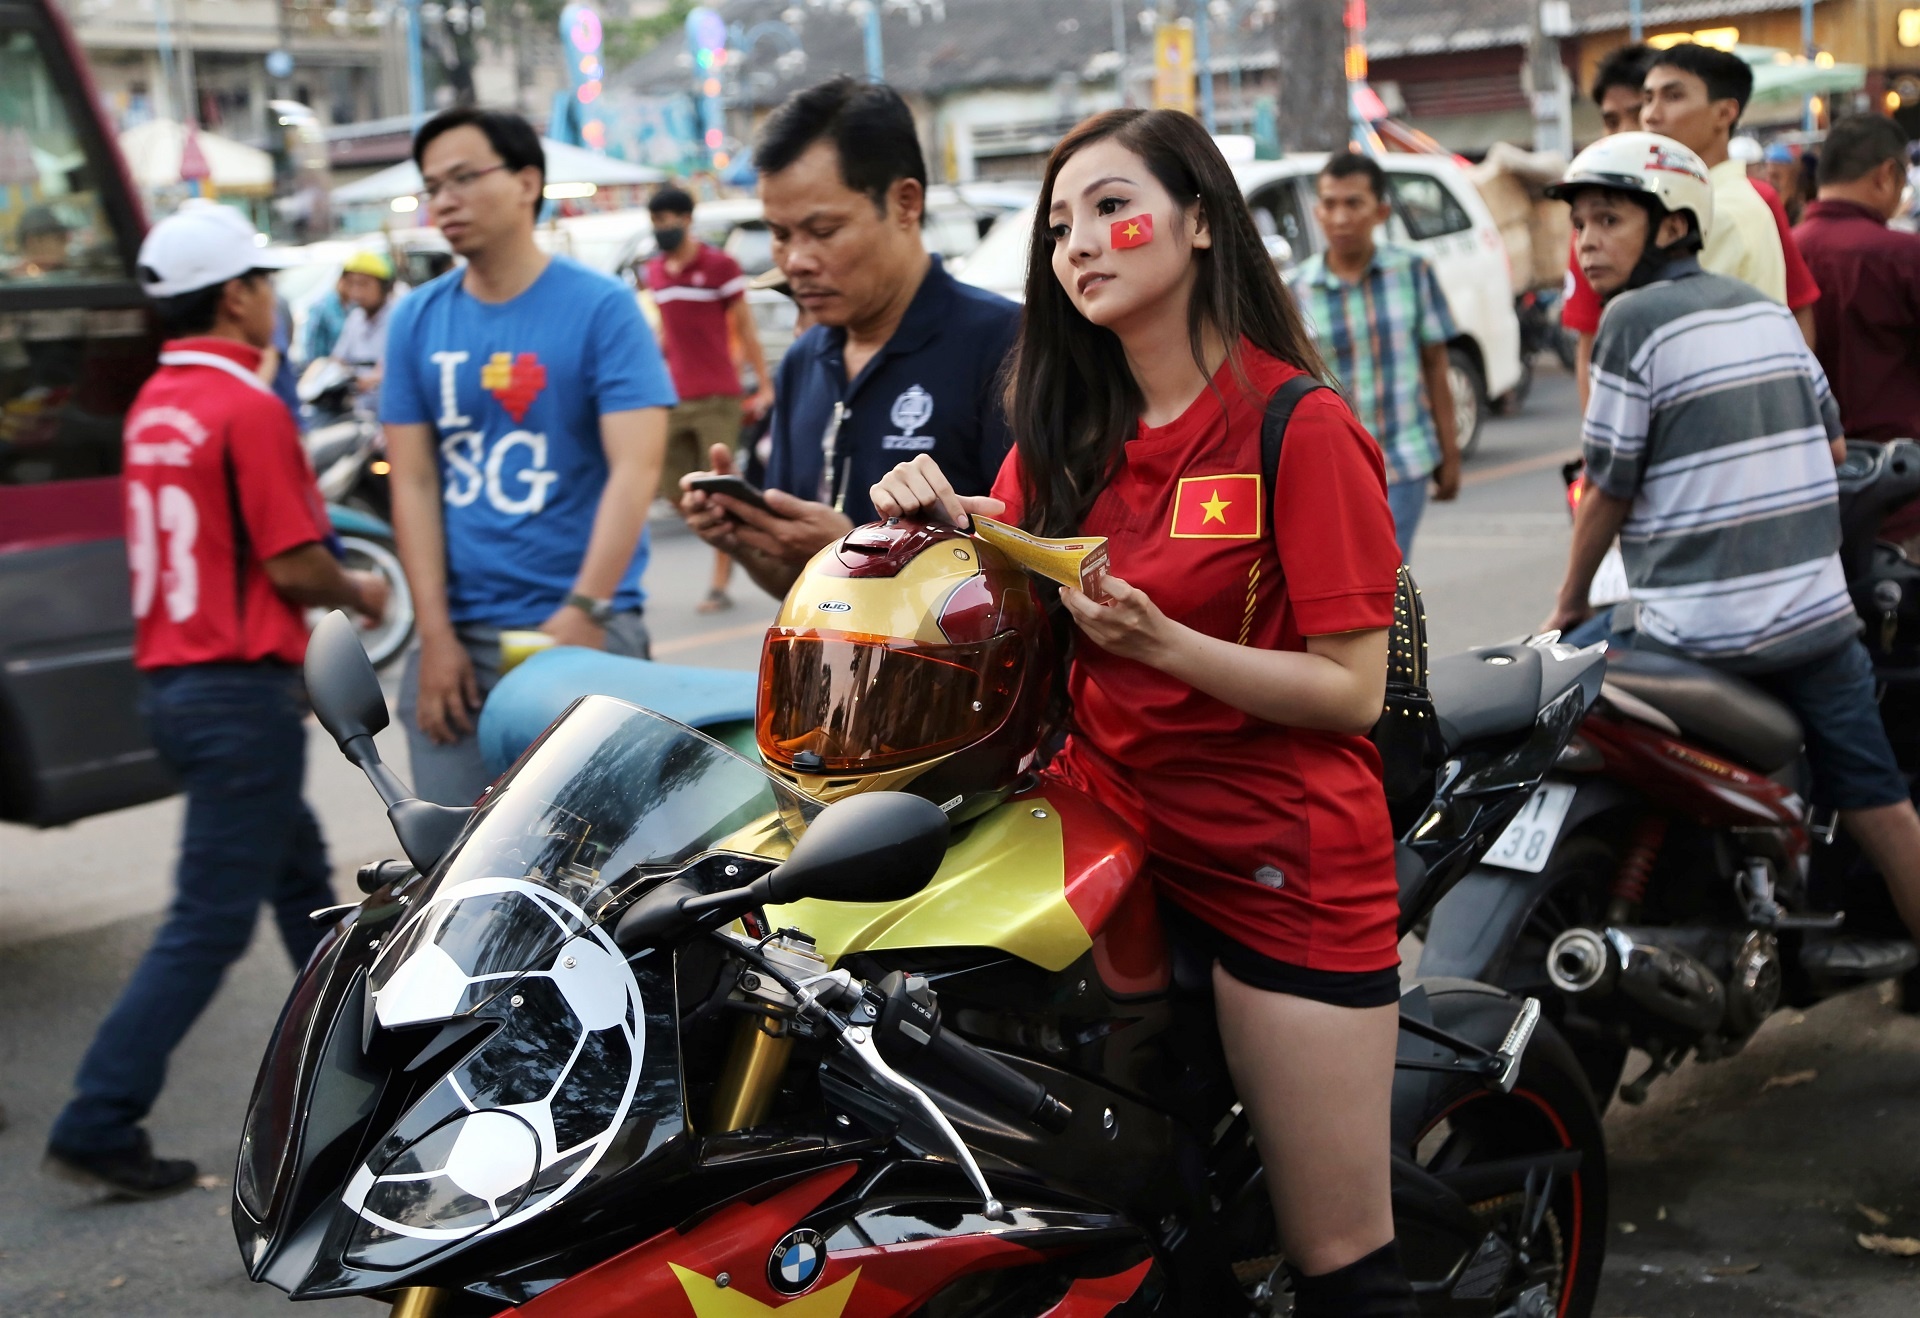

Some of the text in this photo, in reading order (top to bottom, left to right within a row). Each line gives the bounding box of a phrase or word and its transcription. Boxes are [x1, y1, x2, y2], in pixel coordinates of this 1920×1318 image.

[430, 351, 471, 428] I
[441, 430, 559, 515] SG
[774, 1232, 822, 1259] BMW
